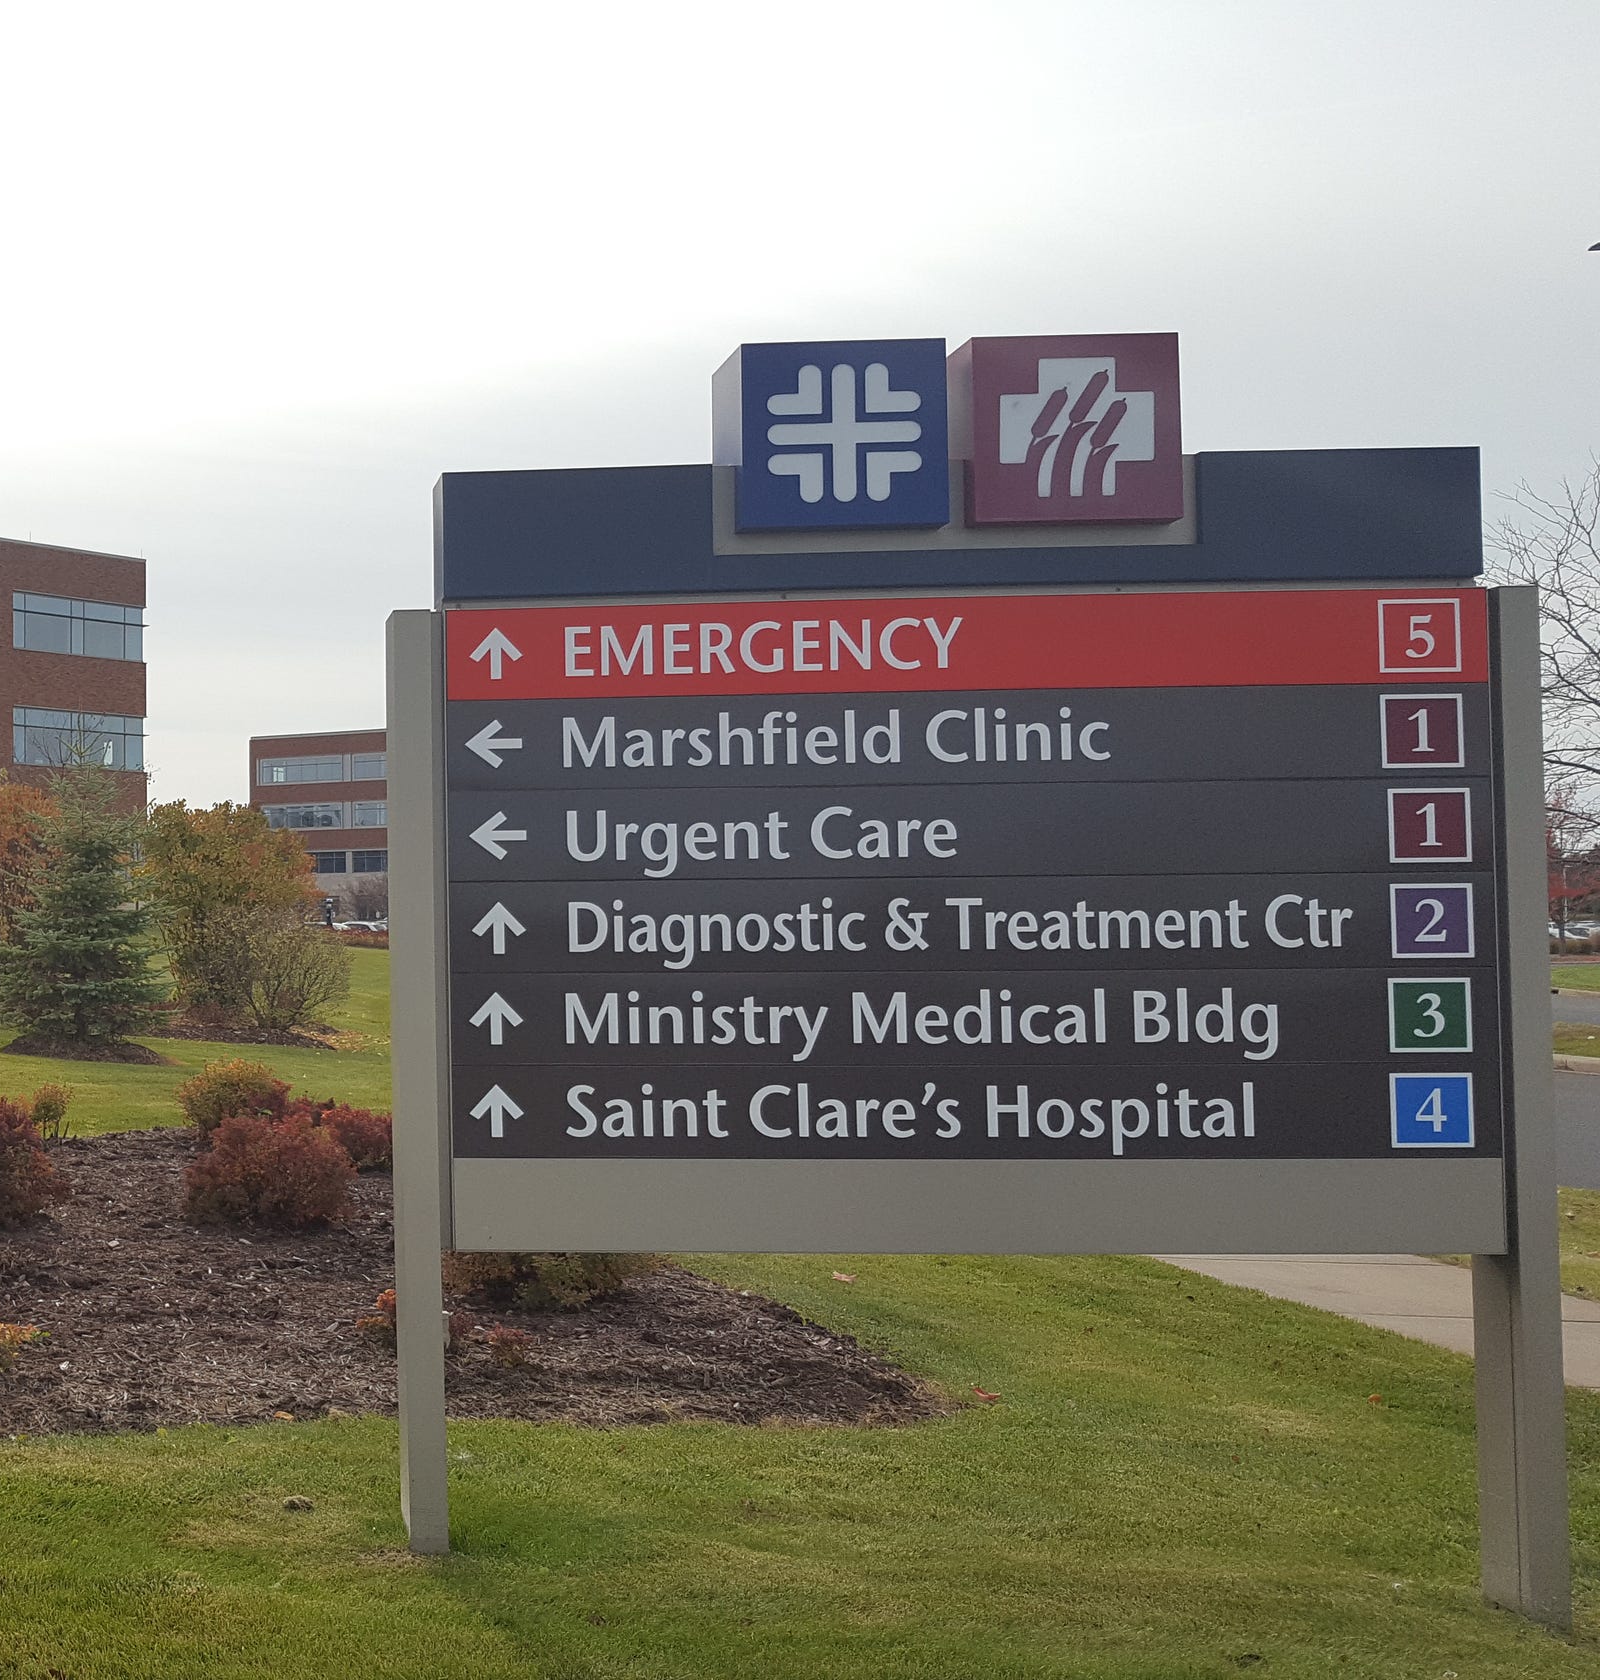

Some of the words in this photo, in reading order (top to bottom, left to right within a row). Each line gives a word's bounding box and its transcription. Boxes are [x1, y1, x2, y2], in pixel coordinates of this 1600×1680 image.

[564, 616, 964, 677] EMERGENCY
[1405, 614, 1436, 658] 5
[562, 708, 901, 768] Marshfield
[925, 706, 1112, 763] Clinic
[1407, 708, 1435, 752] 1
[566, 809, 791, 878] Urgent
[810, 805, 958, 860] Care
[1415, 802, 1443, 846] 1
[568, 896, 867, 970] Diagnostic
[884, 897, 930, 951] &
[945, 897, 1250, 951] Treatment
[1264, 893, 1354, 949] Ctr
[1414, 898, 1448, 942] 2
[565, 990, 829, 1062] Ministry
[851, 988, 1106, 1045] Medical
[1133, 987, 1279, 1061] Bldg
[1413, 992, 1446, 1038] 3
[566, 1083, 729, 1138] Saint
[749, 1082, 962, 1139] Clare's
[986, 1081, 1255, 1156] Hospital
[1415, 1087, 1449, 1133] 4
